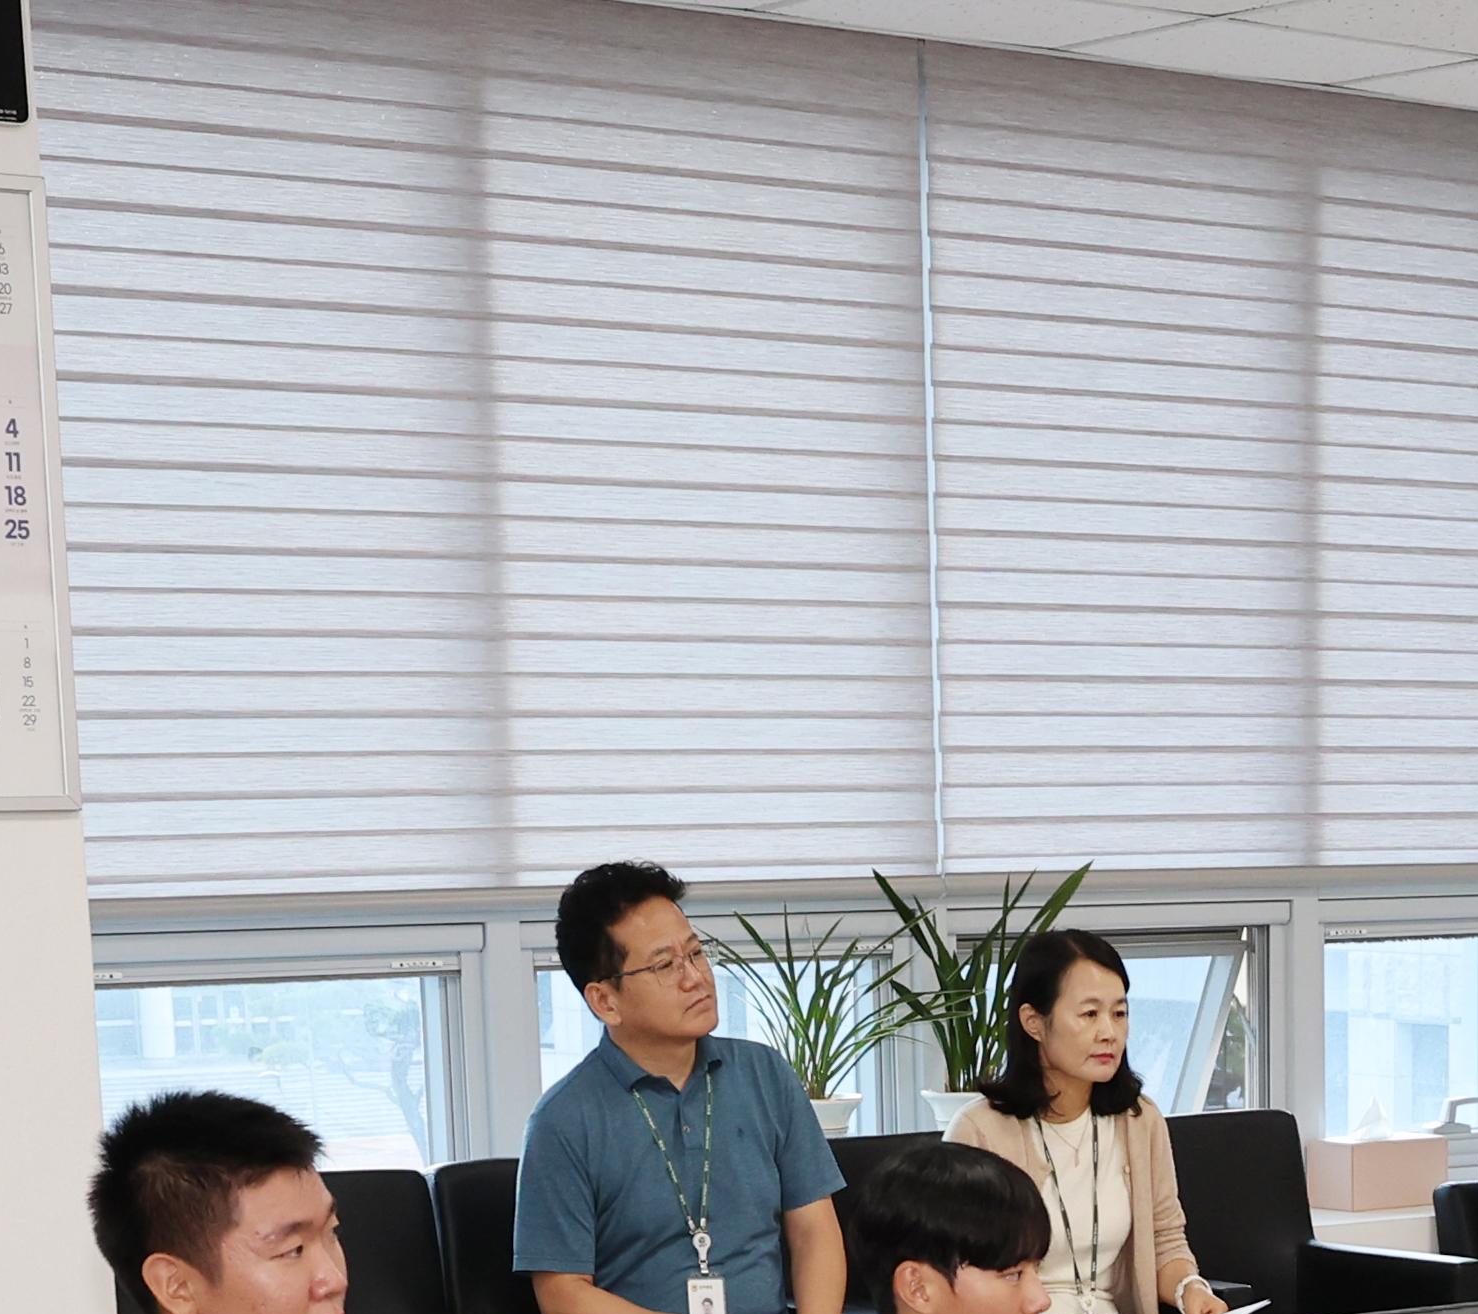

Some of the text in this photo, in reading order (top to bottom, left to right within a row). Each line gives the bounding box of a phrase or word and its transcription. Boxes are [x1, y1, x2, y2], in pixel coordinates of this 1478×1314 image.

[0, 302, 12, 314] 27
[5, 418, 19, 438] 4
[5, 452, 20, 472] 11
[5, 486, 26, 506] 18
[5, 519, 30, 539] 25
[24, 638, 29, 649] 1
[23, 657, 31, 668] 8
[23, 676, 34, 688] 15
[22, 695, 36, 706] 22
[23, 714, 37, 726] 29
